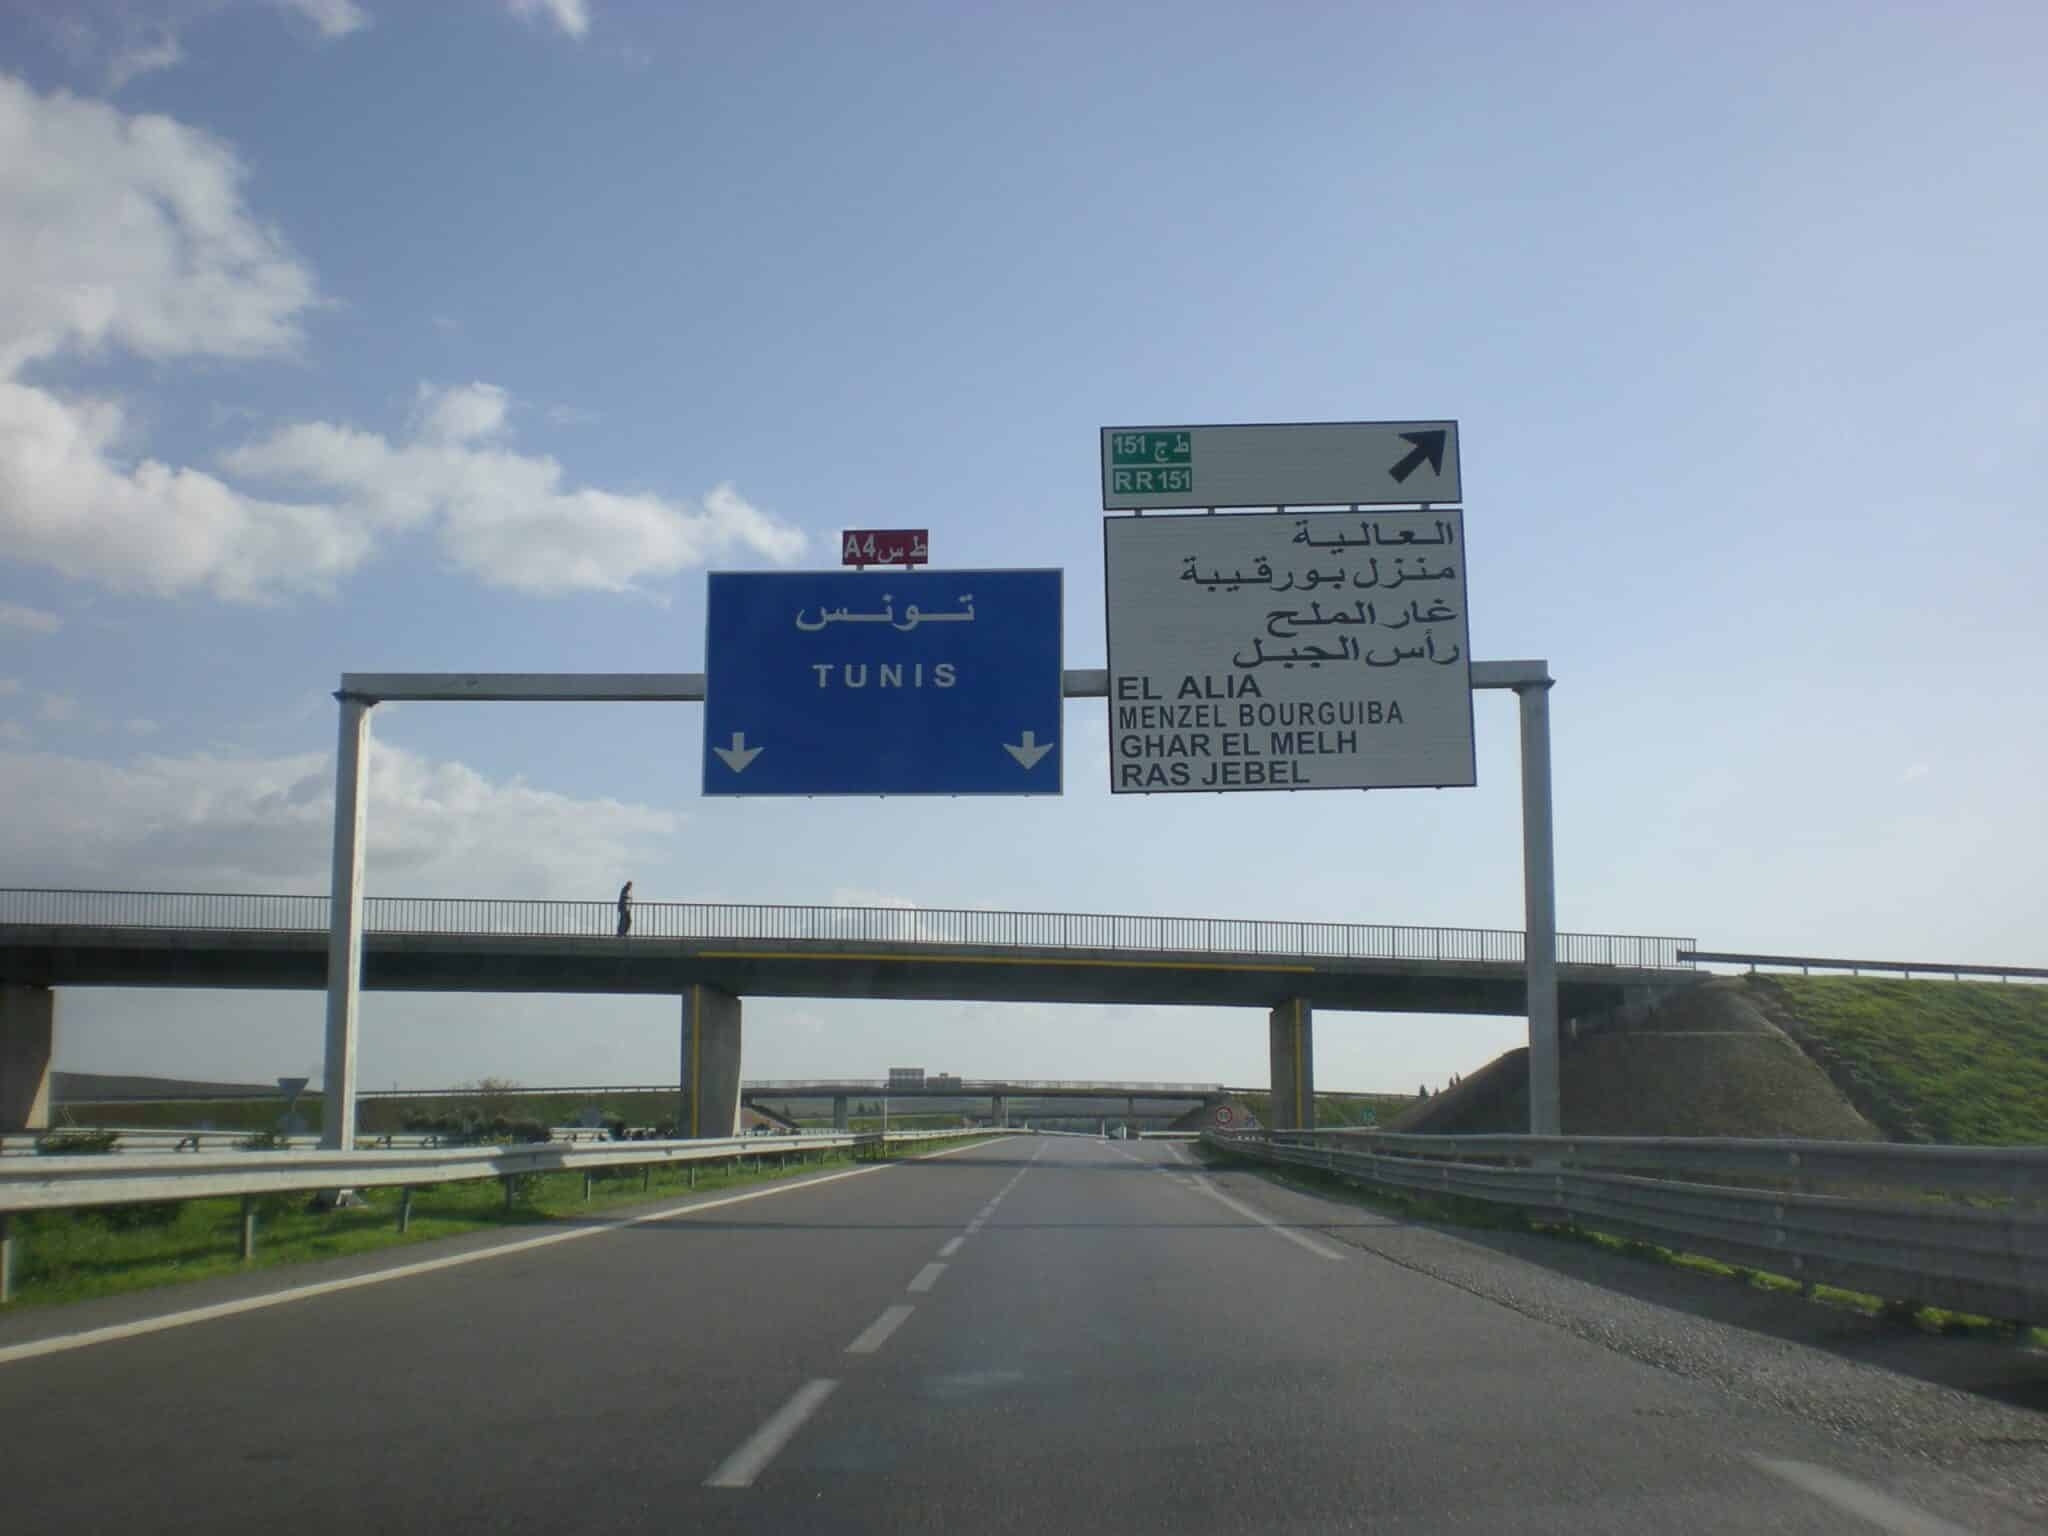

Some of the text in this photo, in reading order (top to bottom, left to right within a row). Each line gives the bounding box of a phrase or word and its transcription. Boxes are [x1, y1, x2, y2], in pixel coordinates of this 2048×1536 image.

[1115, 435, 1146, 454] 151
[1157, 470, 1190, 488] 151
[846, 534, 876, 558] A4
[1292, 519, 1453, 554] العالية
[1180, 556, 1455, 592] منزل بورقيبة
[796, 593, 975, 631] تونس
[1267, 598, 1457, 637] غار الملح
[1233, 630, 1459, 668] رأس الجبل
[812, 663, 957, 689] TUNIS
[1118, 674, 1262, 700] EL ALIA
[1119, 701, 1403, 728] MENZEL BOURGUIBA
[1121, 731, 1357, 758] GHAR EL MELH
[1122, 761, 1310, 787] RAS JEBEL
